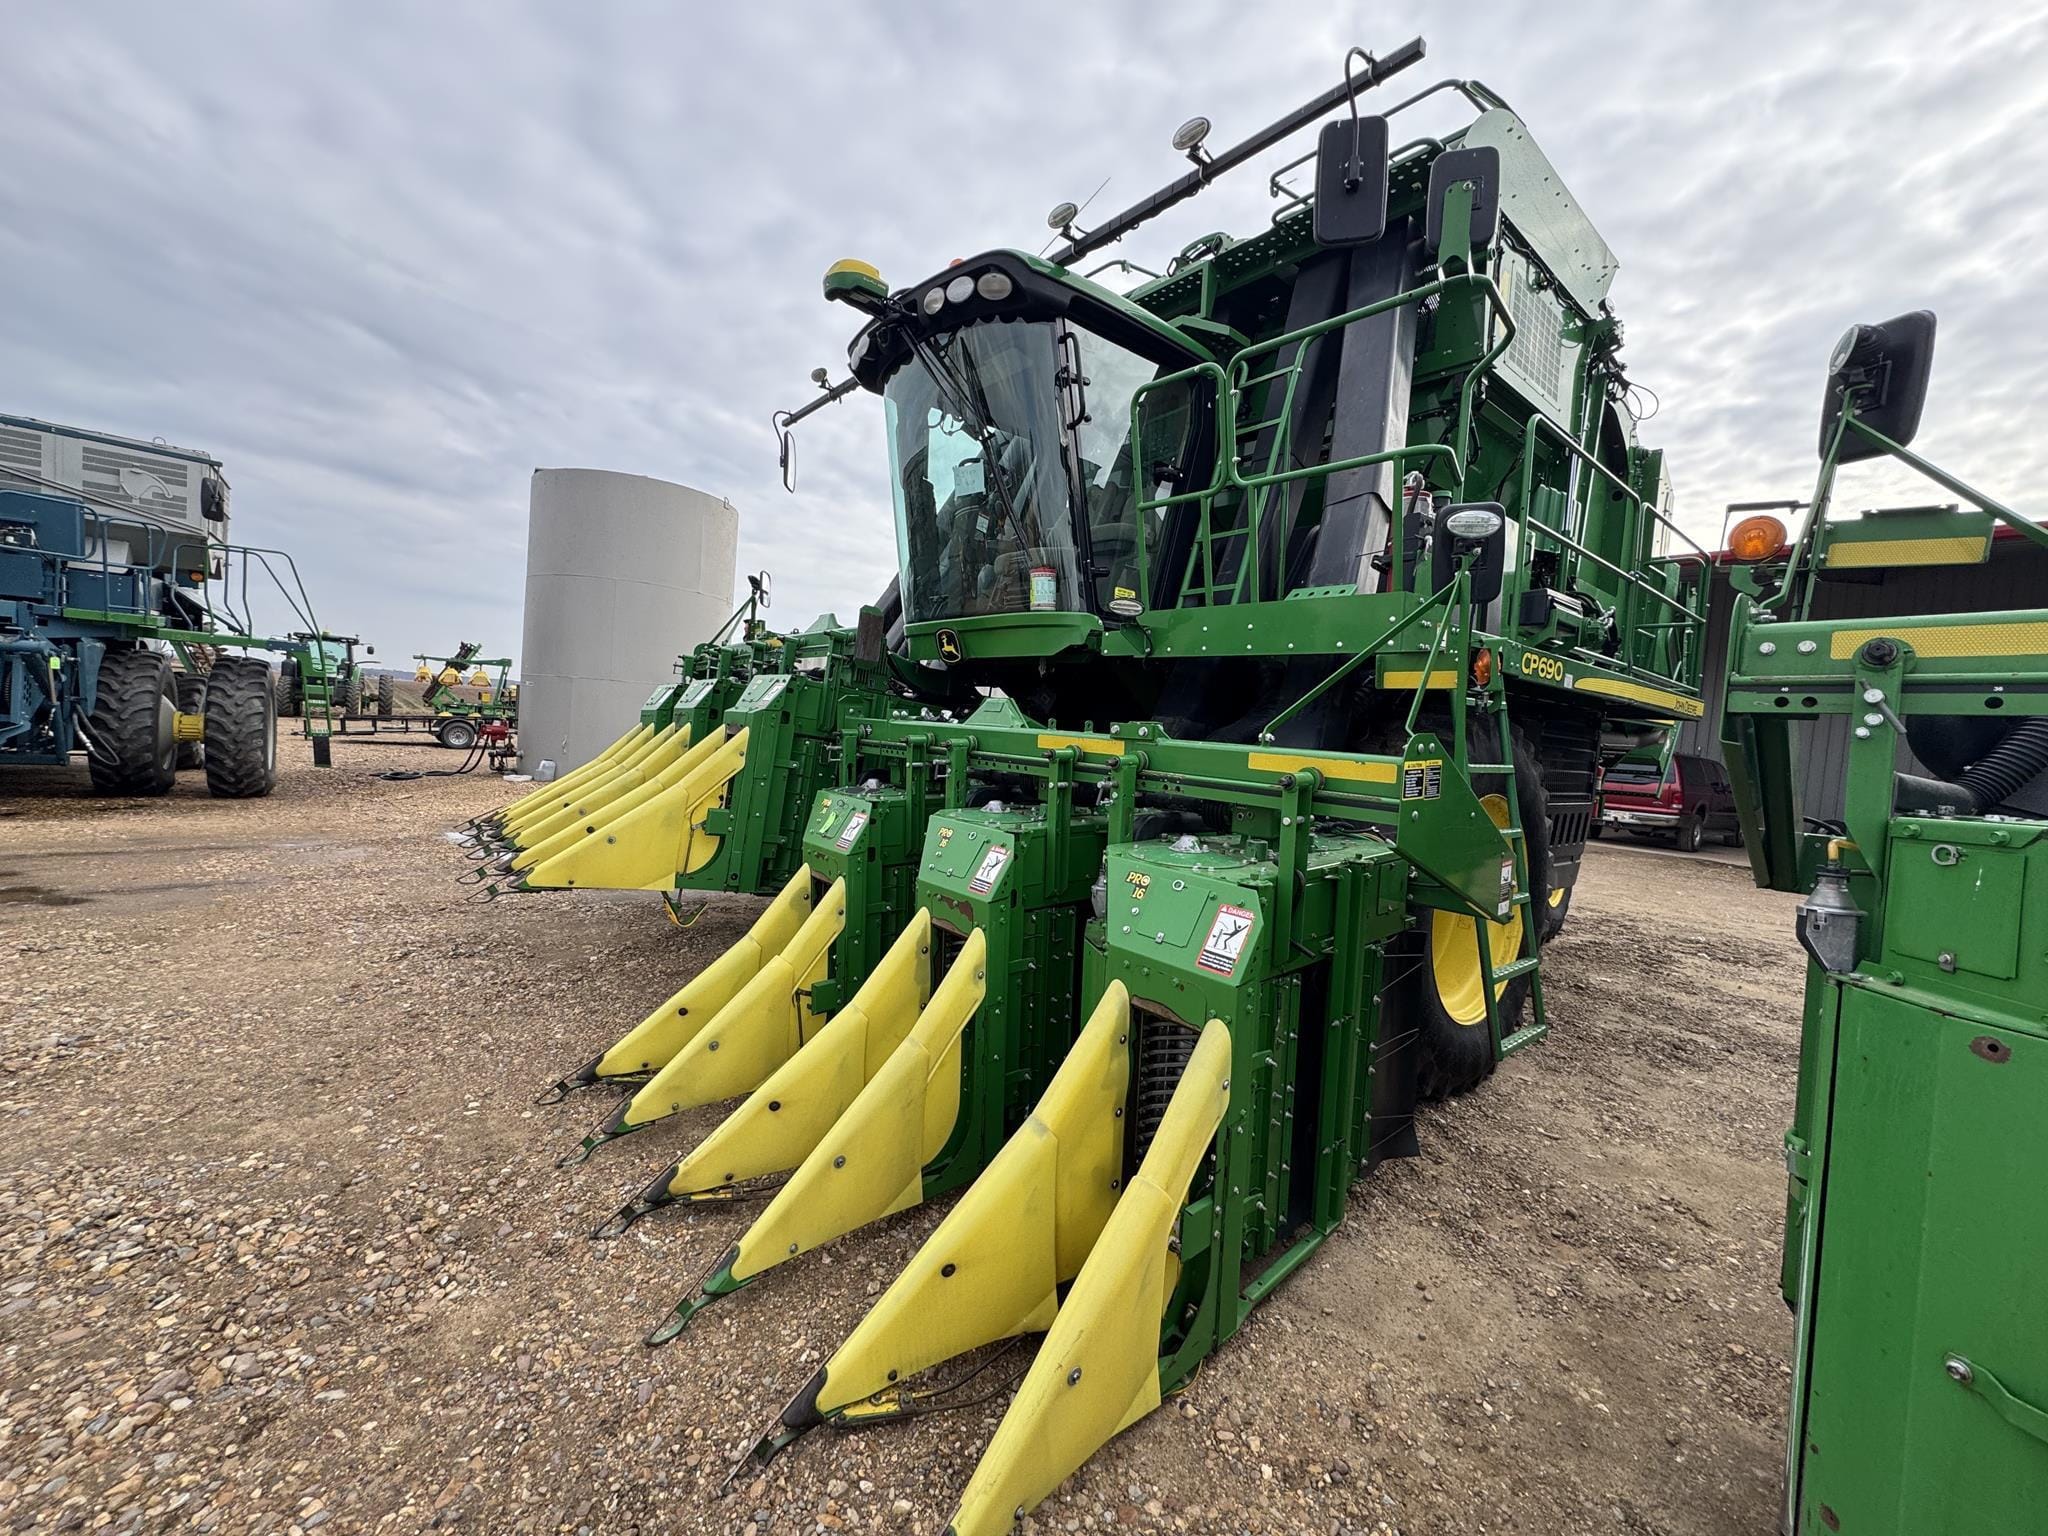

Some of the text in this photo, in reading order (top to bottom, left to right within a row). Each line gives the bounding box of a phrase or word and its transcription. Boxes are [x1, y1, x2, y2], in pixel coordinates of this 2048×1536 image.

[1521, 652, 1563, 681] CP690
[1674, 698, 1698, 715] JOHN DEERE
[938, 827, 954, 839] PRO
[1126, 871, 1151, 886] PRO
[1132, 886, 1146, 899] 16
[1227, 907, 1255, 919] DANGER
